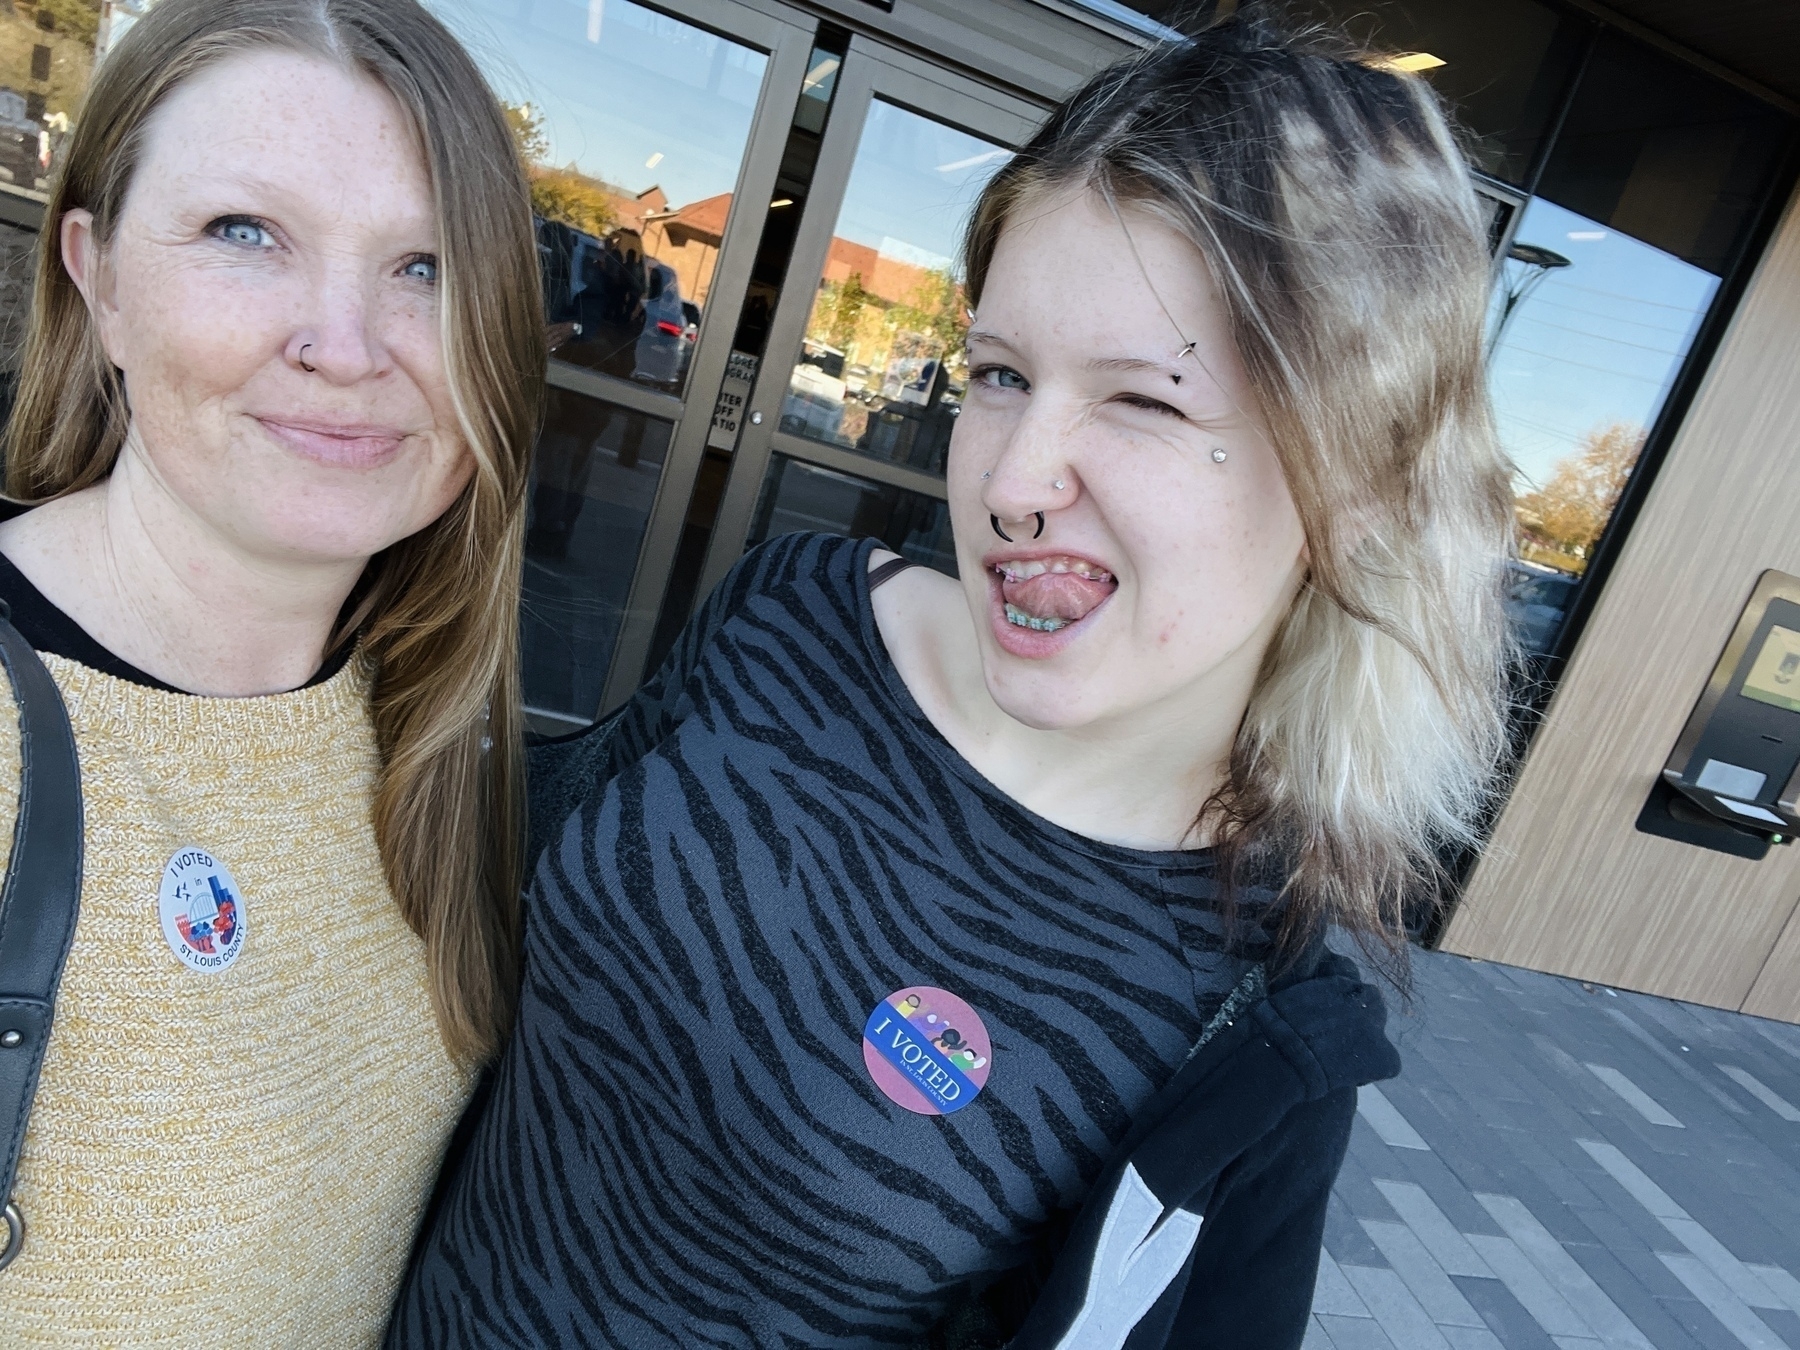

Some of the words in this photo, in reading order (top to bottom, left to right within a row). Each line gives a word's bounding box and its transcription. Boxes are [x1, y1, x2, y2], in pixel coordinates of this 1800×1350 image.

[719, 393, 742, 407] TER
[170, 867, 178, 878] I
[174, 852, 213, 871] VOTED
[194, 877, 202, 886] in
[179, 943, 192, 961] ST.
[194, 954, 222, 967] LOUIS
[222, 923, 244, 962] COUNTY
[874, 1017, 892, 1035] I
[890, 1028, 961, 1101] VOTED
